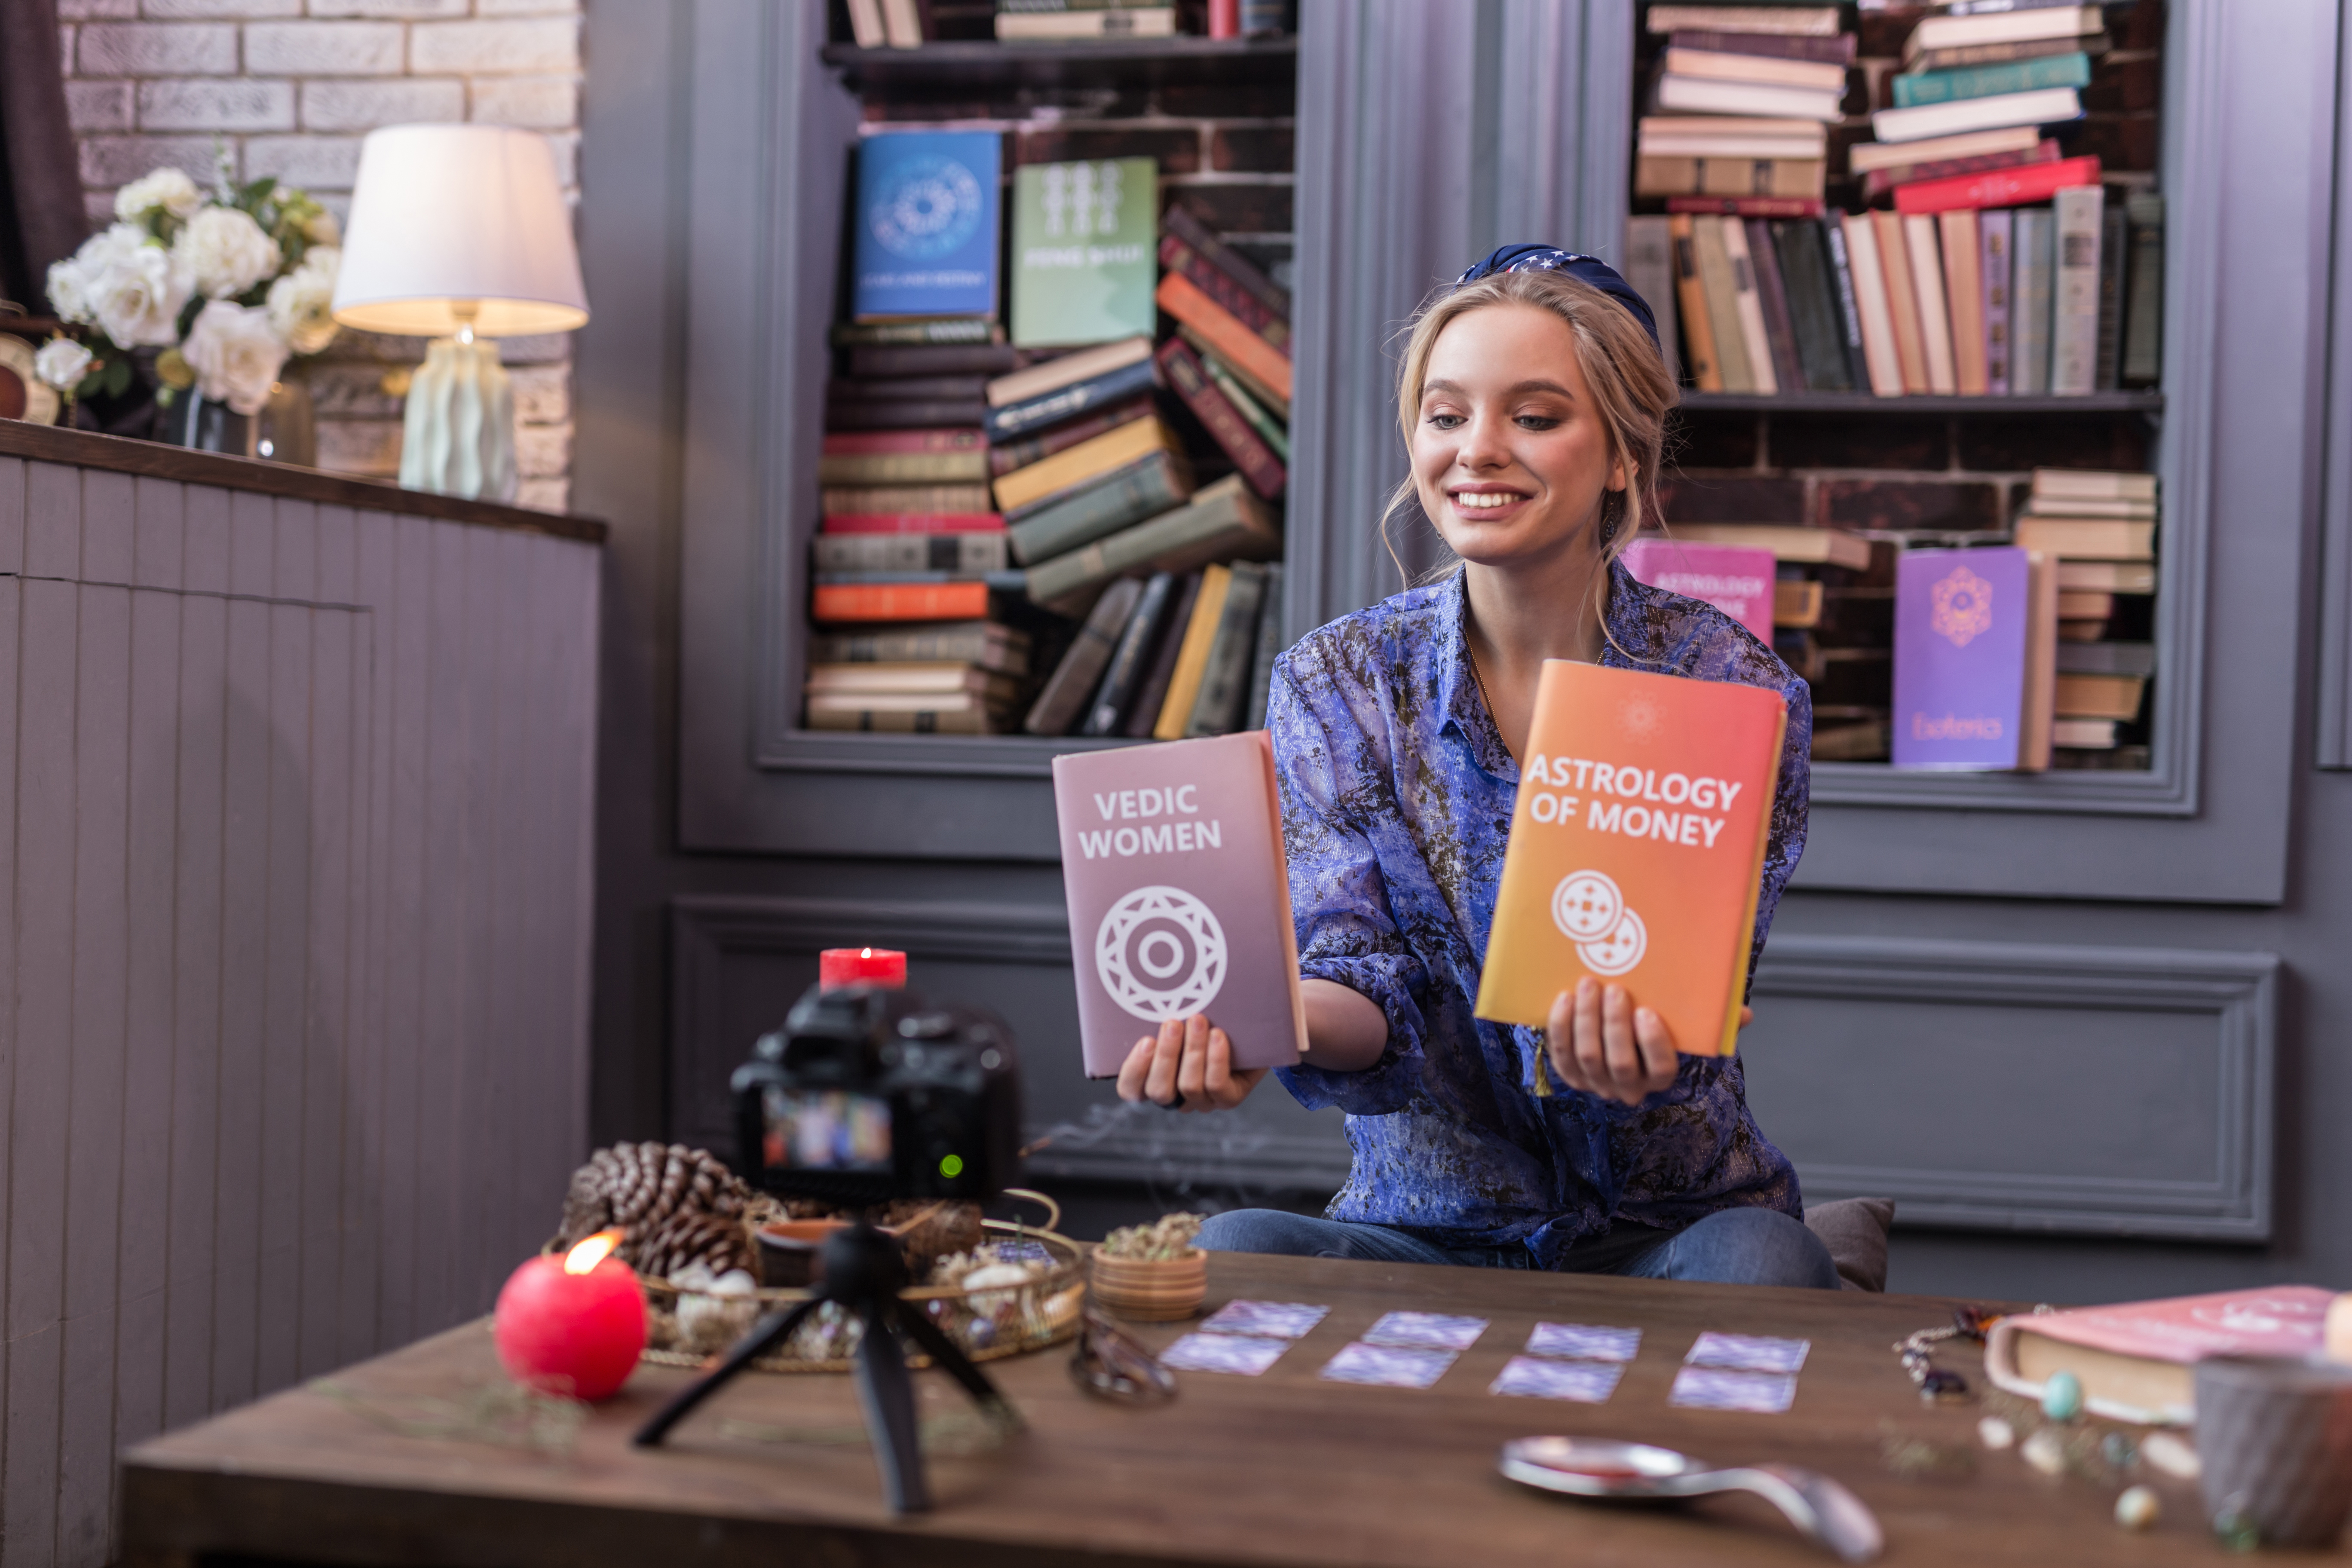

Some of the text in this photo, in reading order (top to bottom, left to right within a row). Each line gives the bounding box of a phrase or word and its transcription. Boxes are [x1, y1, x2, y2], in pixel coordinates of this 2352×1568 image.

[1094, 784, 1198, 821] VEDIC
[1526, 753, 1742, 812] ASTROLOGY
[1078, 820, 1222, 859] WOMEN
[1530, 793, 1725, 848] OF MONEY
